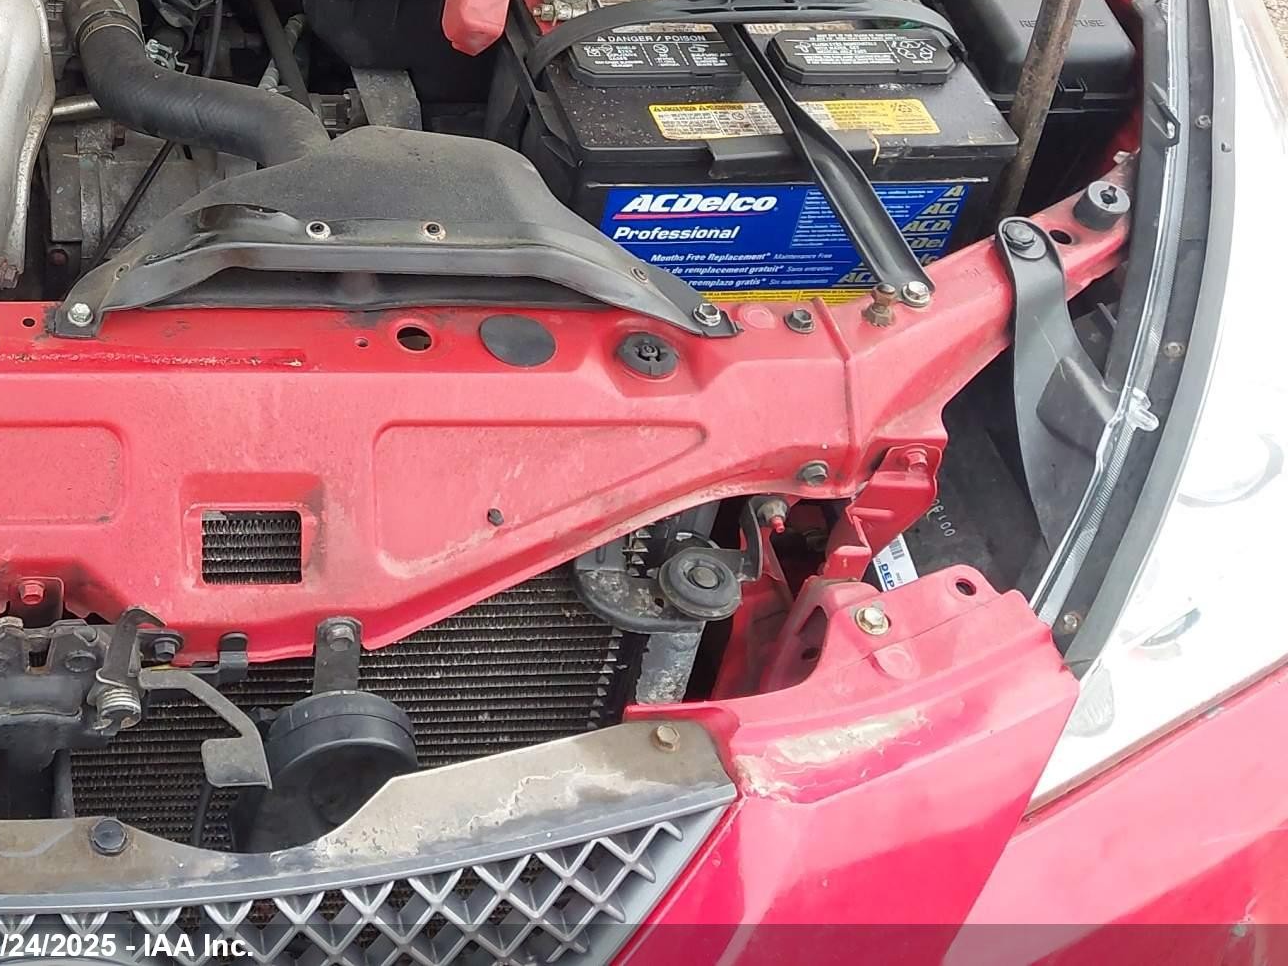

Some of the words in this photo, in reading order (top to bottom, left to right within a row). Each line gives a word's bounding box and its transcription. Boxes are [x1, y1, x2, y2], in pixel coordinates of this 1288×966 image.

[608, 35, 654, 43] DANGER
[620, 192, 778, 213] ACDelco
[613, 225, 741, 241] Professional
[650, 253, 685, 263] Months
[686, 253, 707, 262] Free
[684, 266, 749, 275] remplacement
[688, 278, 734, 288] reemplazo
